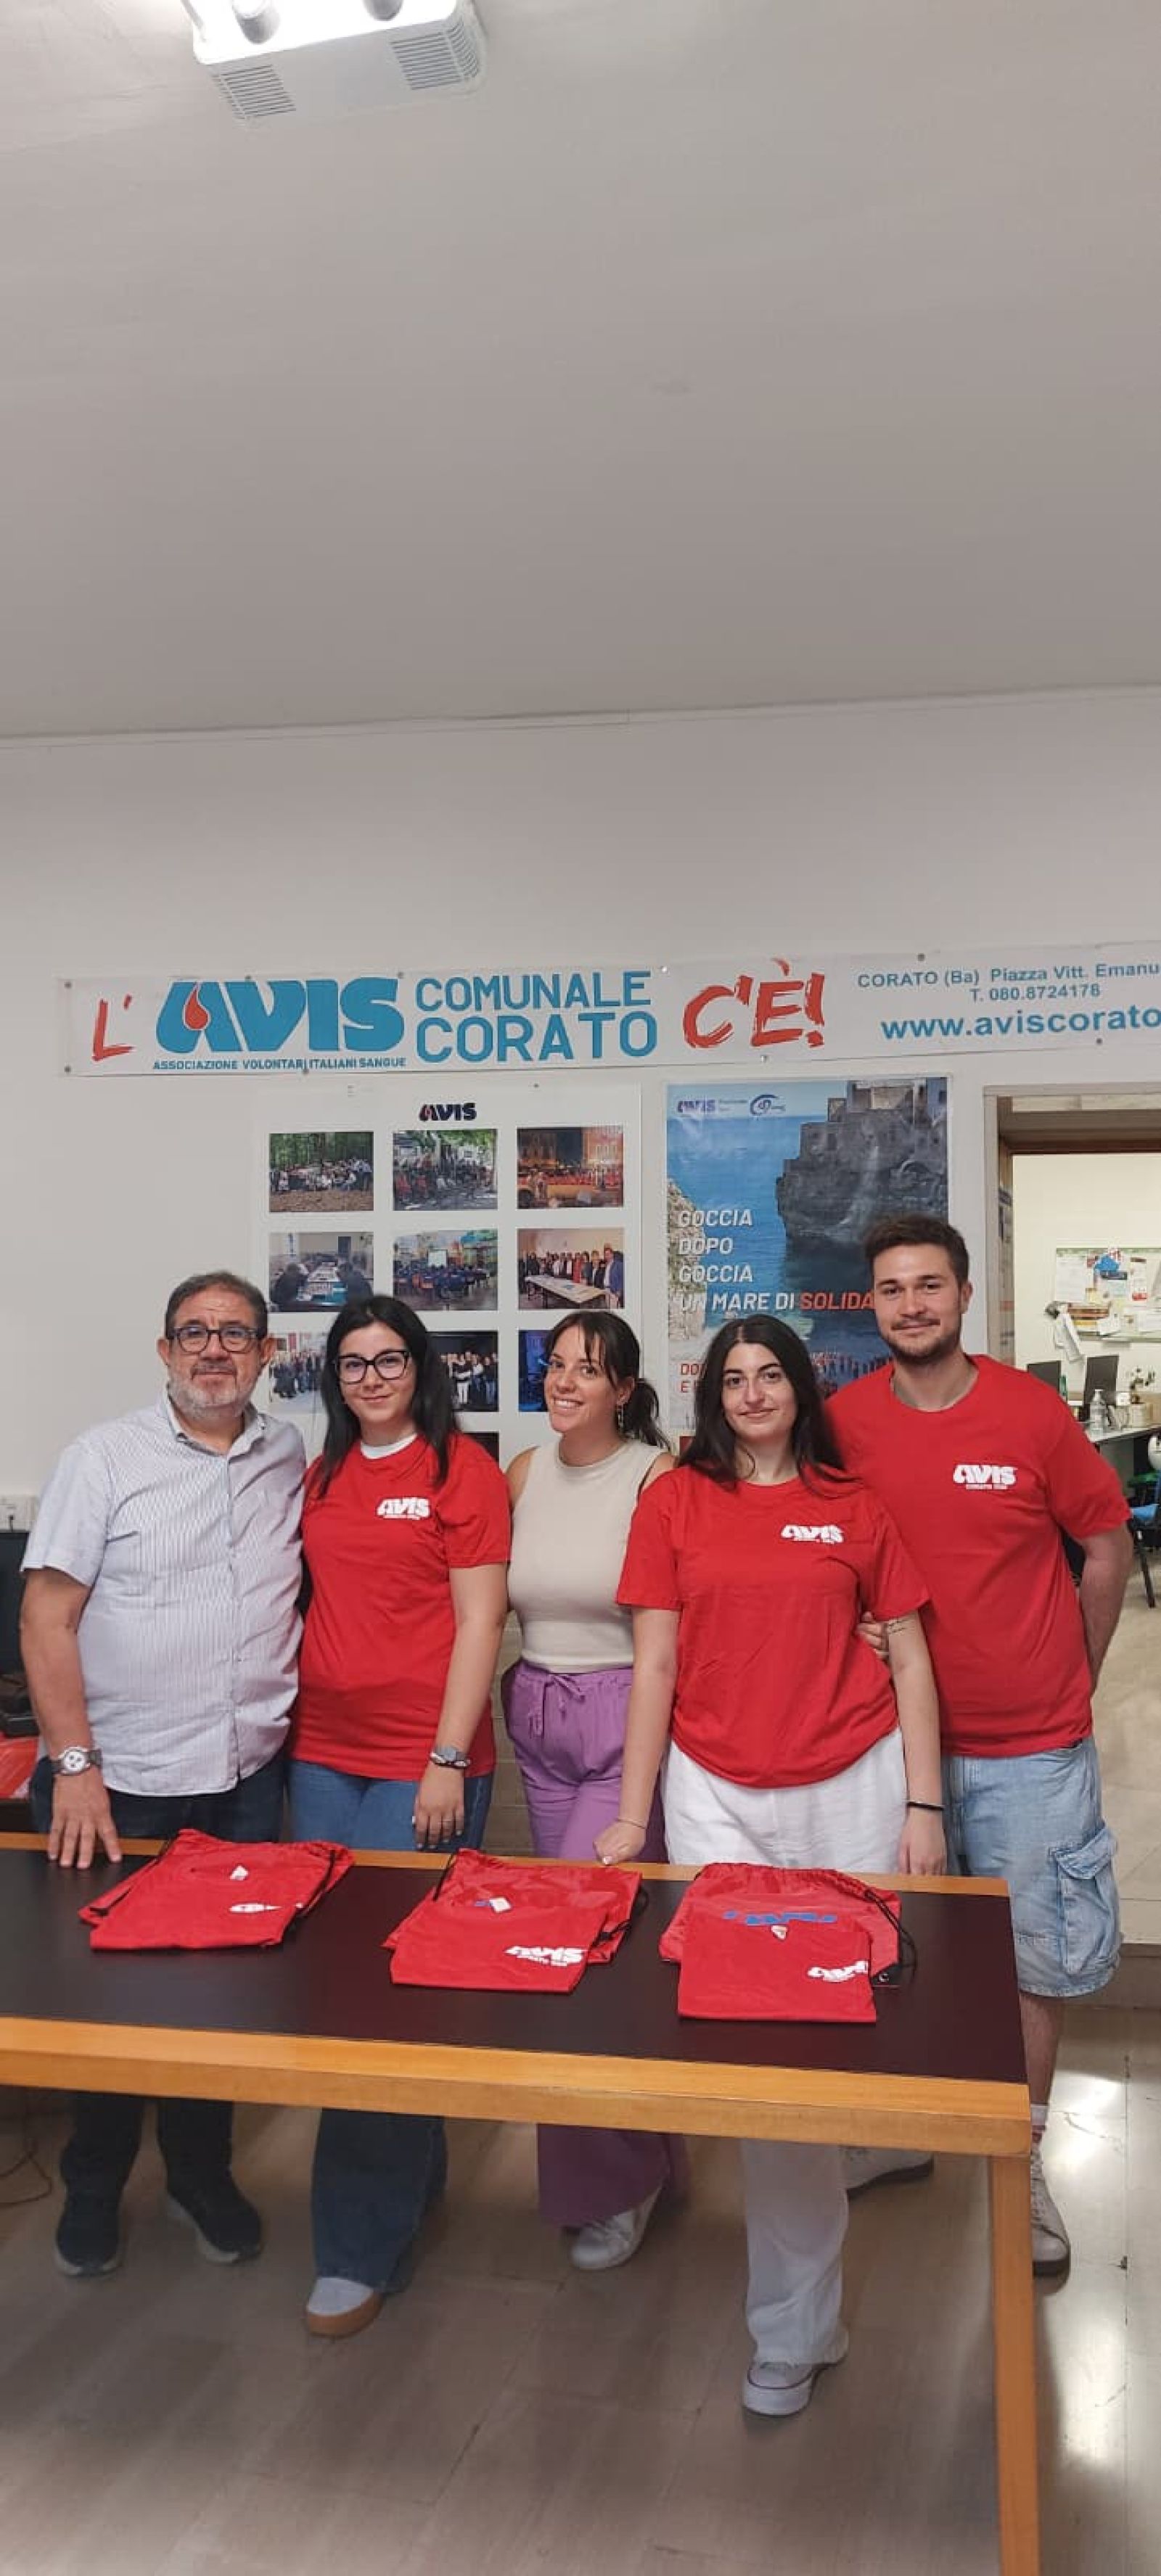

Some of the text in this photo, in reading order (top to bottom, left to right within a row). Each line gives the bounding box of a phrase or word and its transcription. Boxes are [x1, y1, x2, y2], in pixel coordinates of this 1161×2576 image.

[858, 971, 938, 987] CORATO
[945, 967, 980, 986] (Ba)
[991, 968, 1047, 982] Piazza
[1096, 963, 1160, 978] Emanu
[415, 971, 652, 1011] COMUNALE
[969, 988, 984, 1002] T.
[92, 976, 405, 1061] L' AVIS
[880, 1004, 1161, 1040] www.aviscorato
[416, 1011, 657, 1063] CORATO
[153, 1060, 237, 1070] ASSOCIAZIONE
[309, 1058, 356, 1069] ITALIANI
[359, 1057, 406, 1068] SANGUE
[419, 1102, 477, 1122] AVIS
[678, 1209, 753, 1227] GOCCIA
[678, 1237, 734, 1255] DOPO
[678, 1264, 753, 1283] GOCCIA
[713, 1292, 770, 1311] MARE
[775, 1292, 795, 1309] DI
[953, 1464, 1017, 1484] AVIS
[377, 1497, 430, 1517] AVIS
[781, 1524, 844, 1543] AVIS
